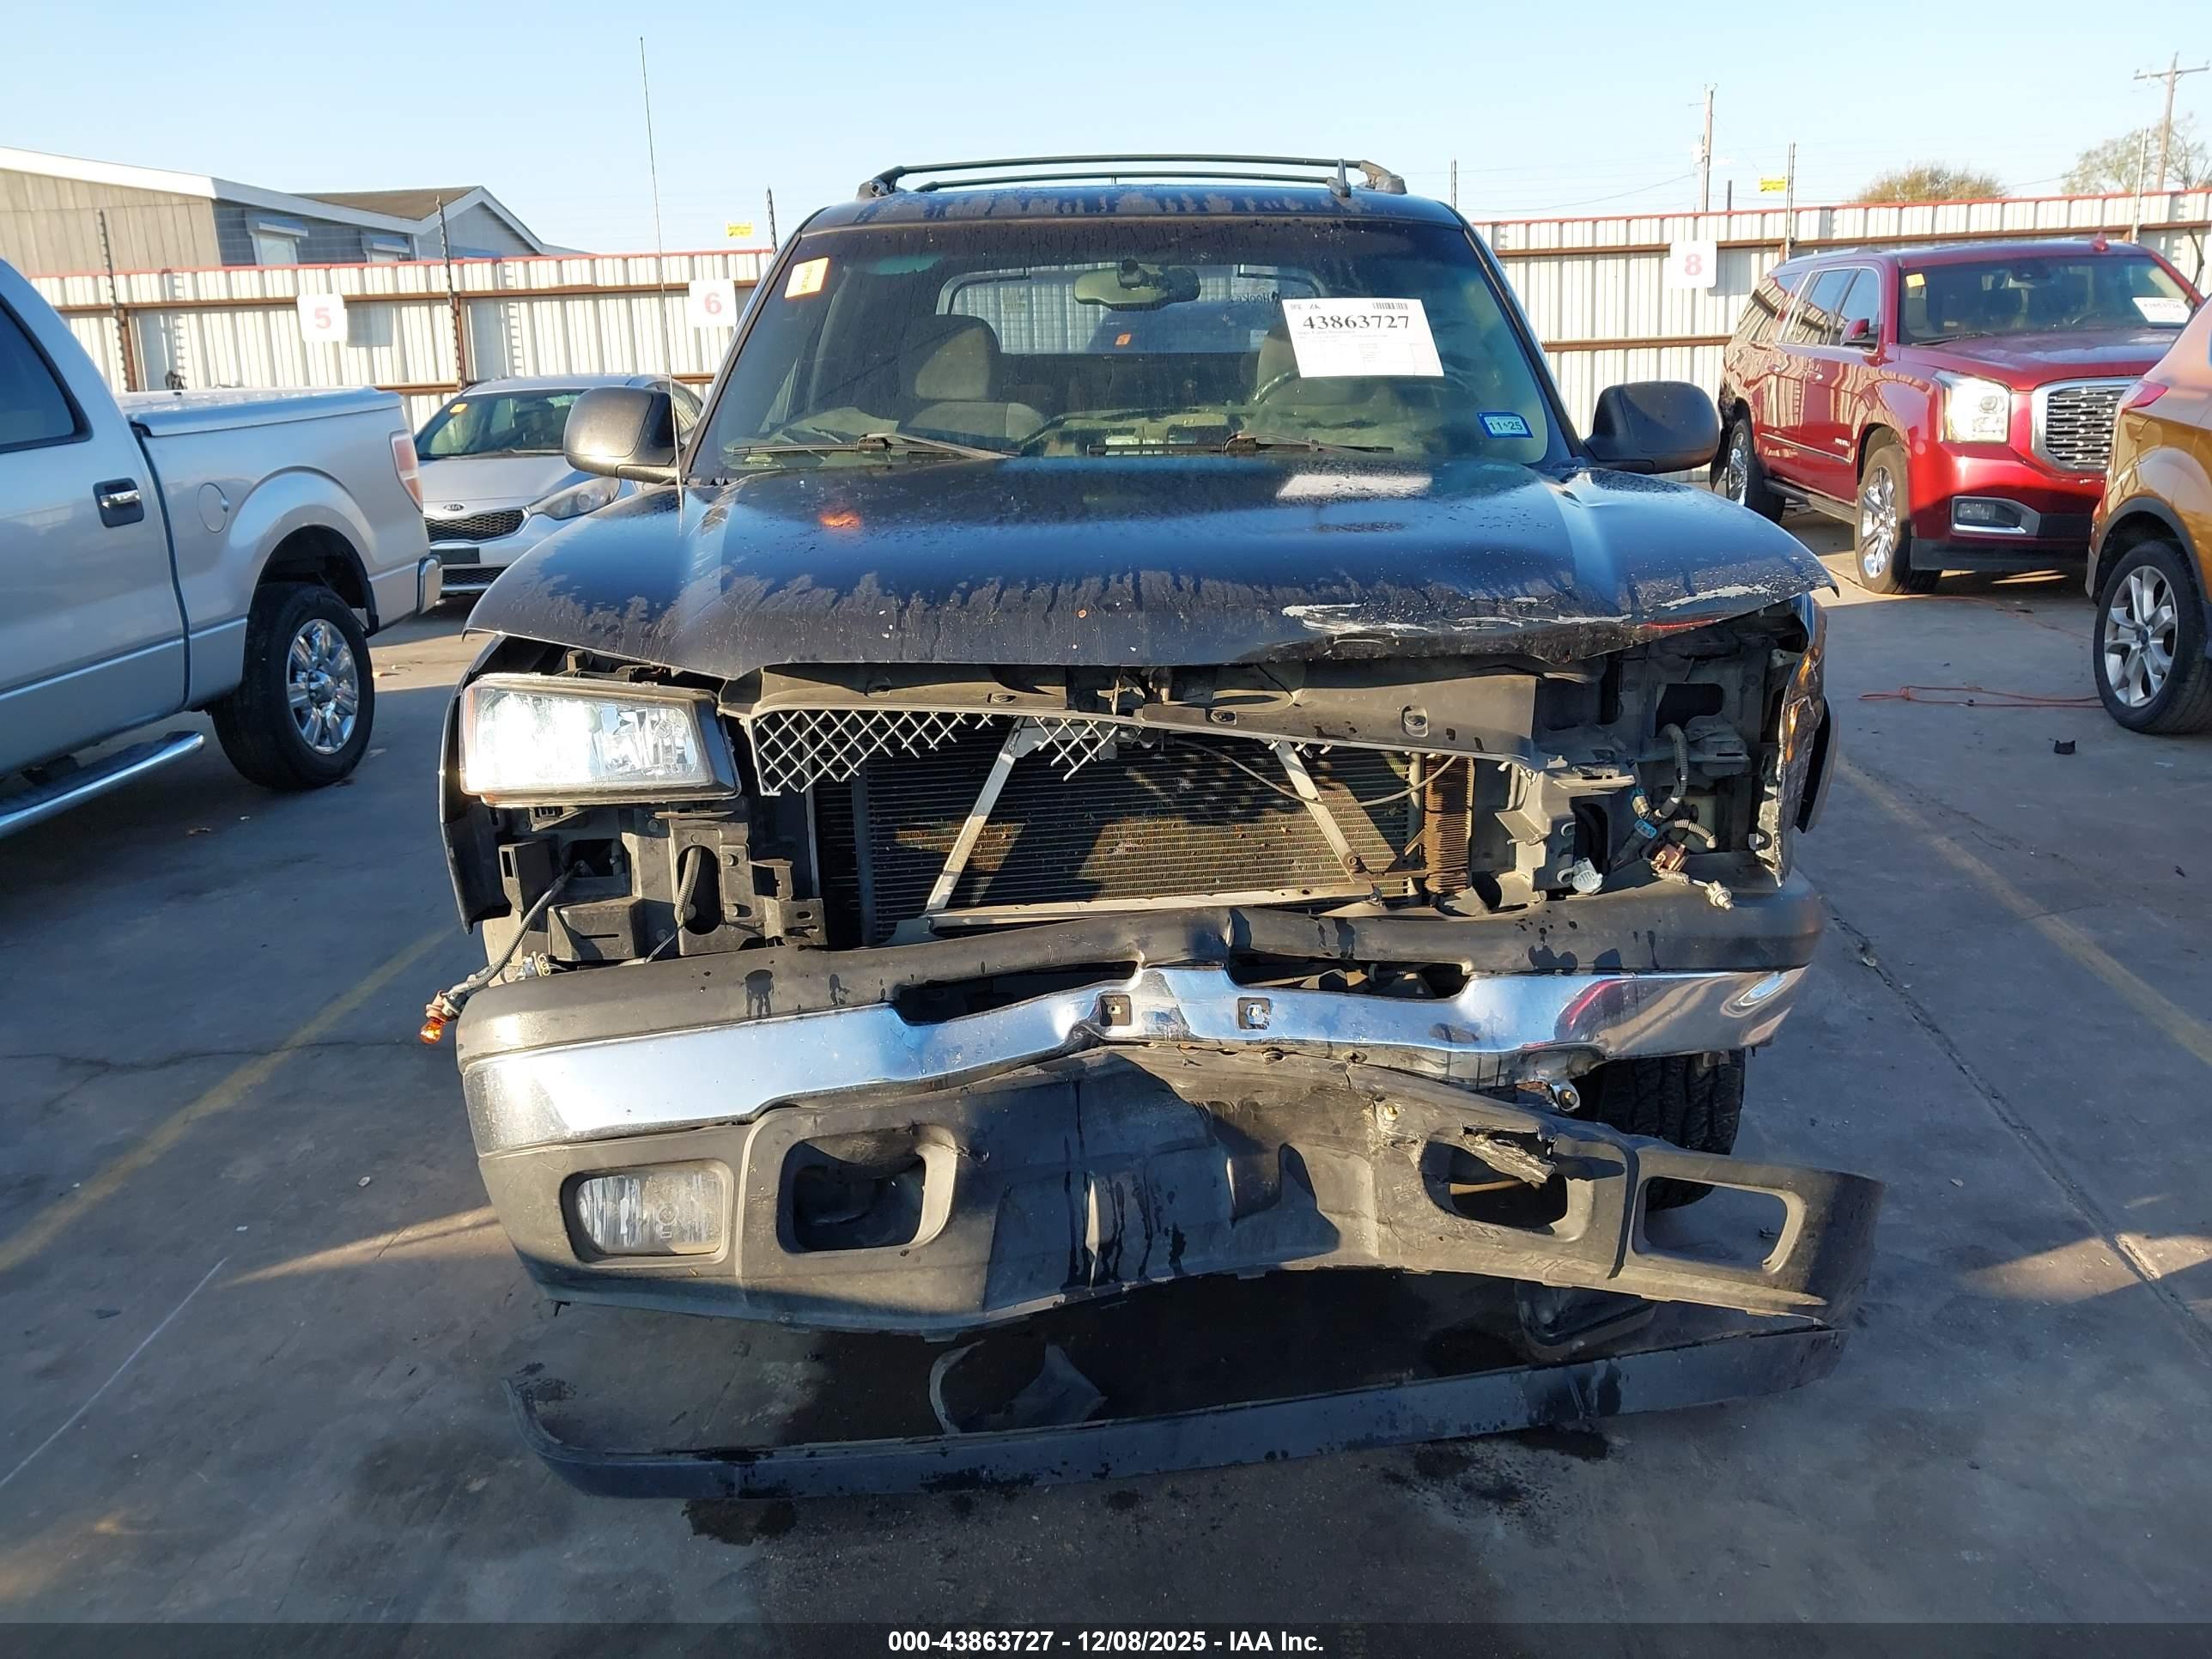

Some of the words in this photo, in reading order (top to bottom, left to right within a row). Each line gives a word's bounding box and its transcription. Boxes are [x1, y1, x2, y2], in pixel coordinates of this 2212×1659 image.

[1685, 253, 1702, 276] 8
[705, 292, 722, 314] 6
[315, 307, 331, 329] 5
[1303, 314, 1409, 330] 43863727
[1490, 421, 1503, 430] 11
[1508, 421, 1523, 430] 25
